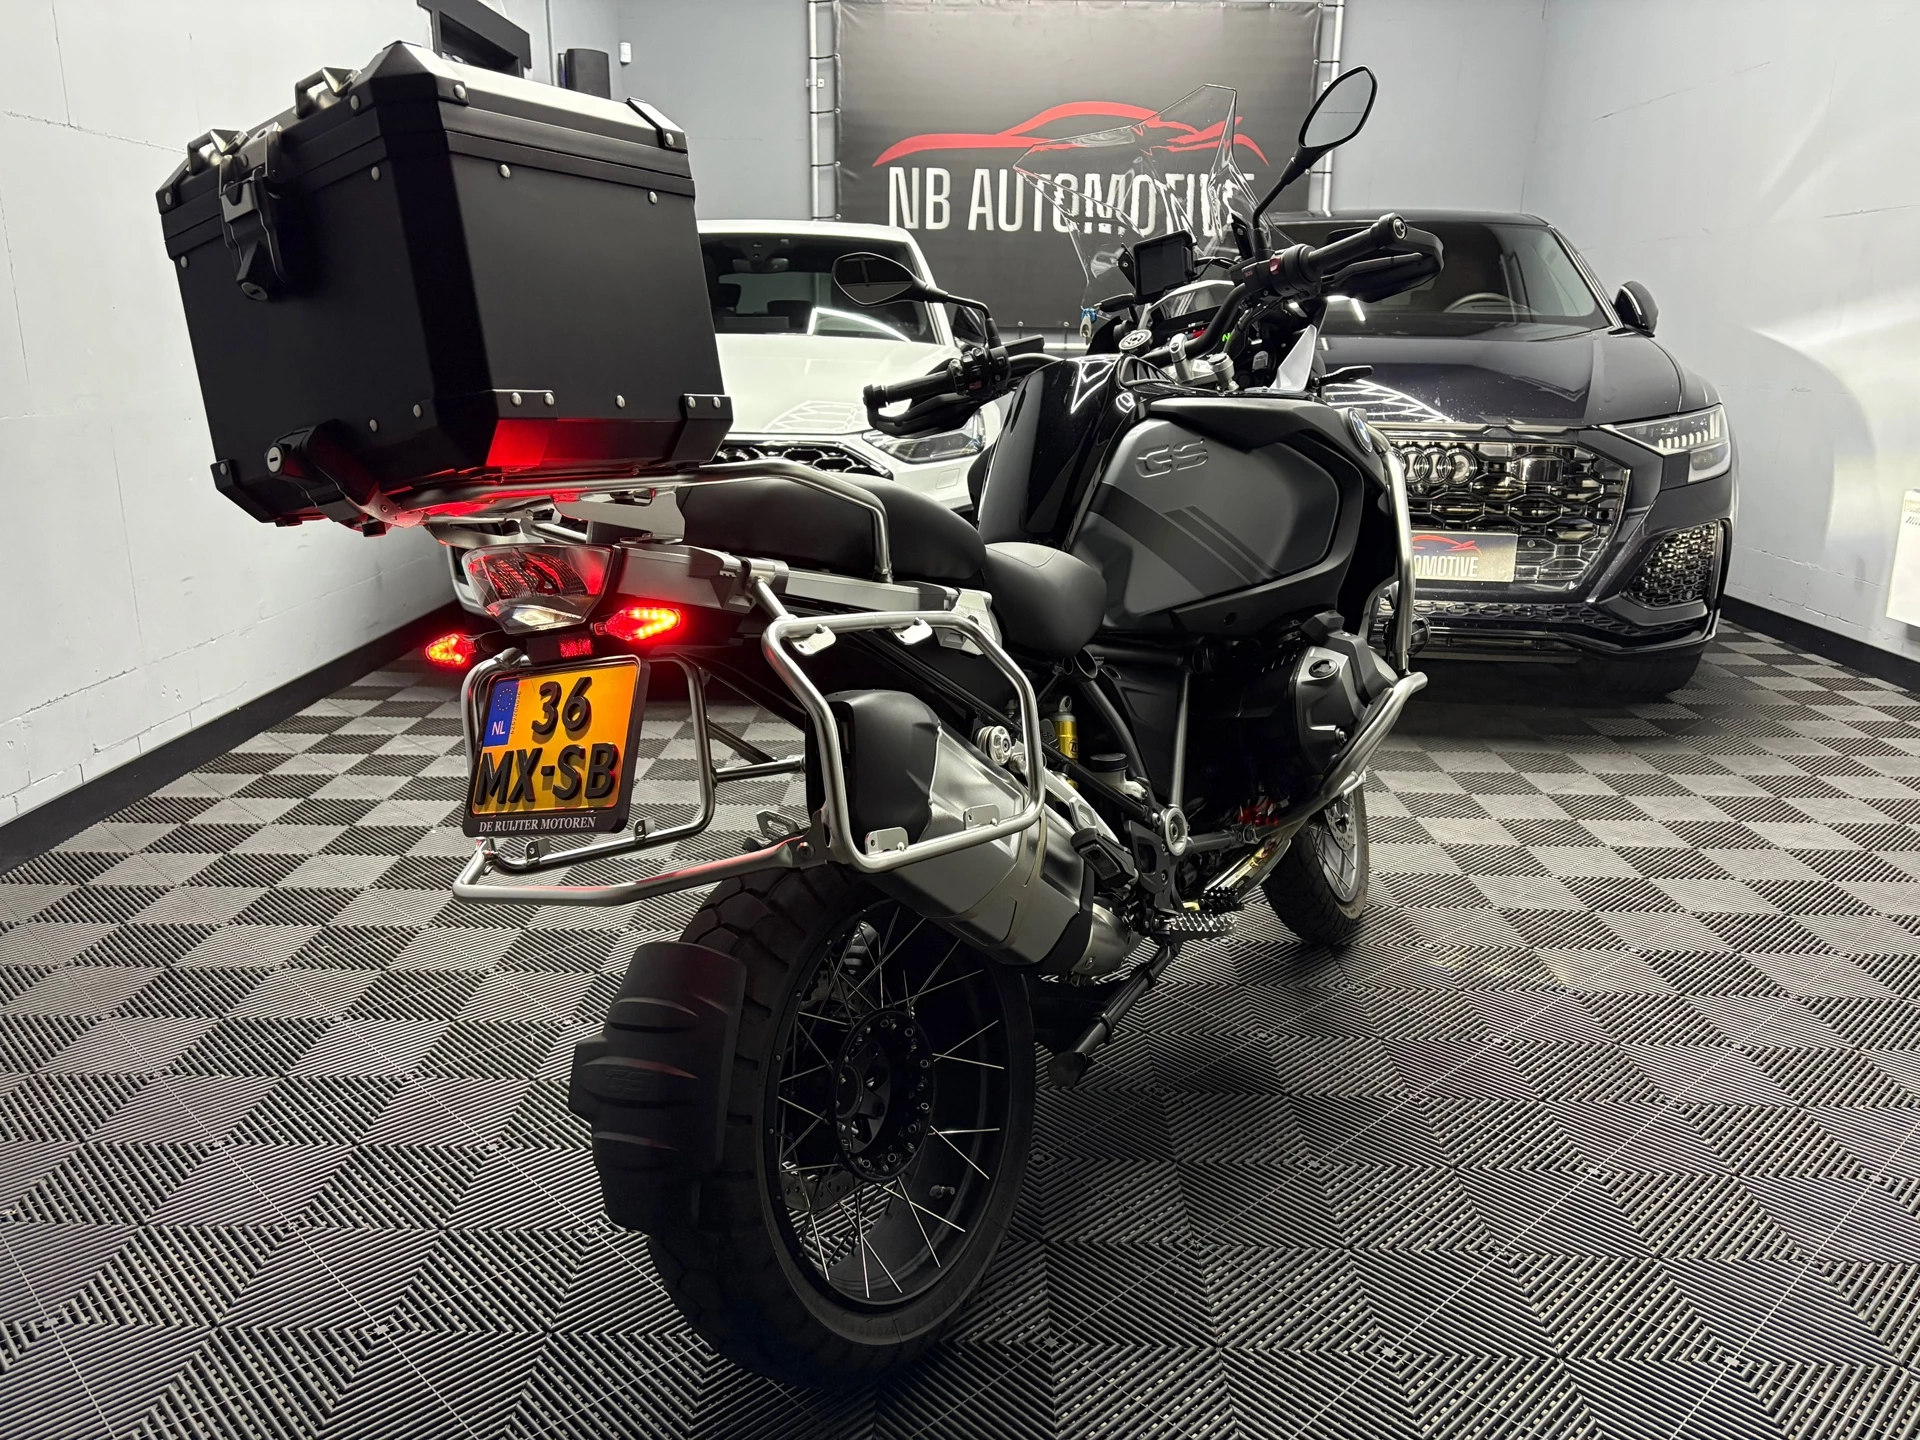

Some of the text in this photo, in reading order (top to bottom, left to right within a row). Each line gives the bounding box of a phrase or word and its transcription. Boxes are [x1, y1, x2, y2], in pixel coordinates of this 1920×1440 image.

[888, 166, 950, 230] NB
[1135, 438, 1208, 478] GS
[1413, 554, 1479, 578] OMOTIVE
[531, 676, 593, 736] 36
[491, 720, 506, 736] NL
[475, 742, 620, 806] MX-SB
[479, 816, 597, 833] DE RUIJTER MOTOREN
